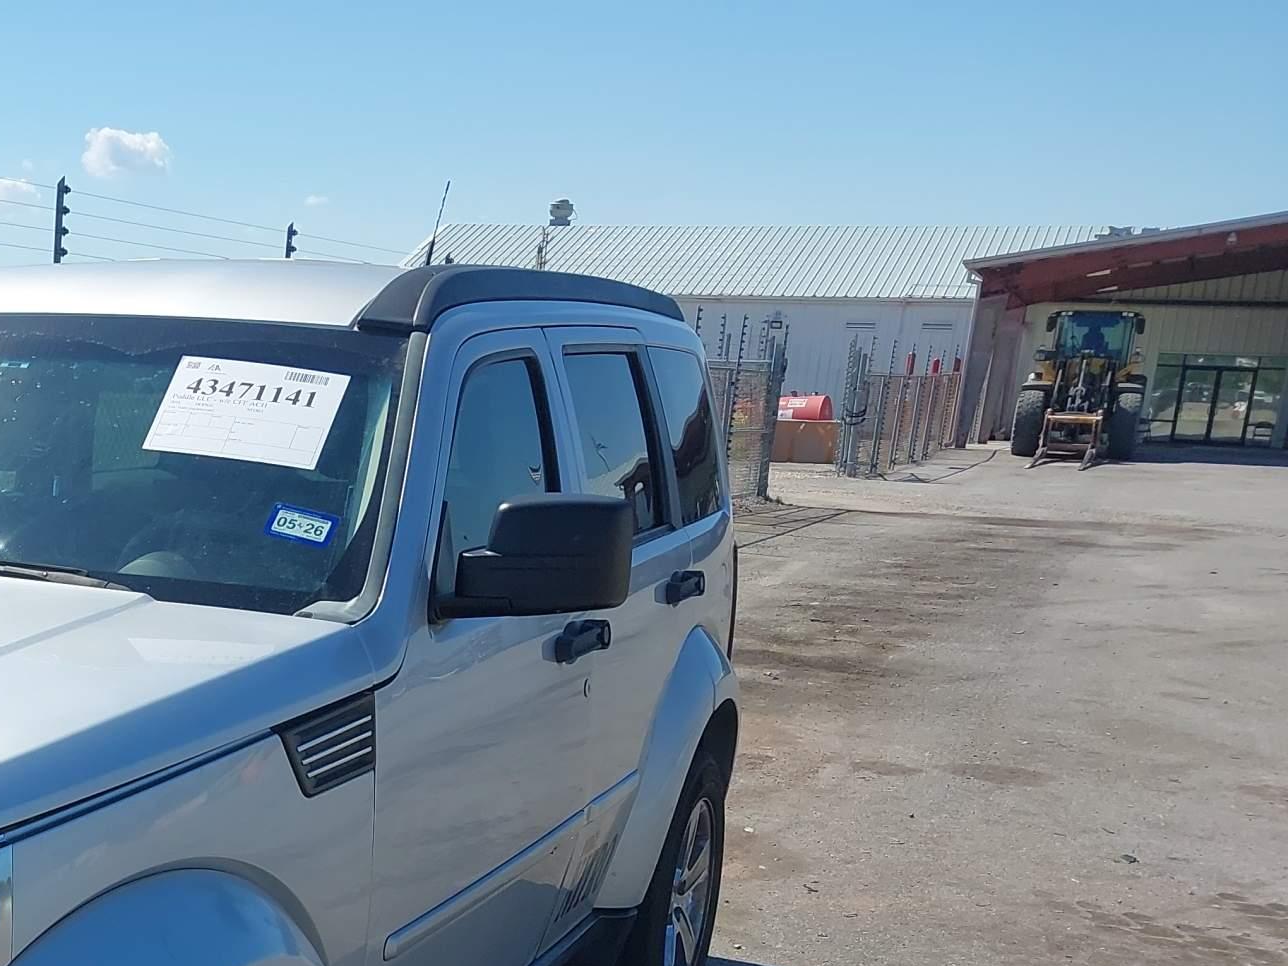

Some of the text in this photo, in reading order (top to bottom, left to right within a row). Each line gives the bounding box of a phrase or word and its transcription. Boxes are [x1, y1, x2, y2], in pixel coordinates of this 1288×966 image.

[186, 377, 318, 409] 43471141
[276, 516, 298, 530] 05
[303, 522, 325, 536] 26
